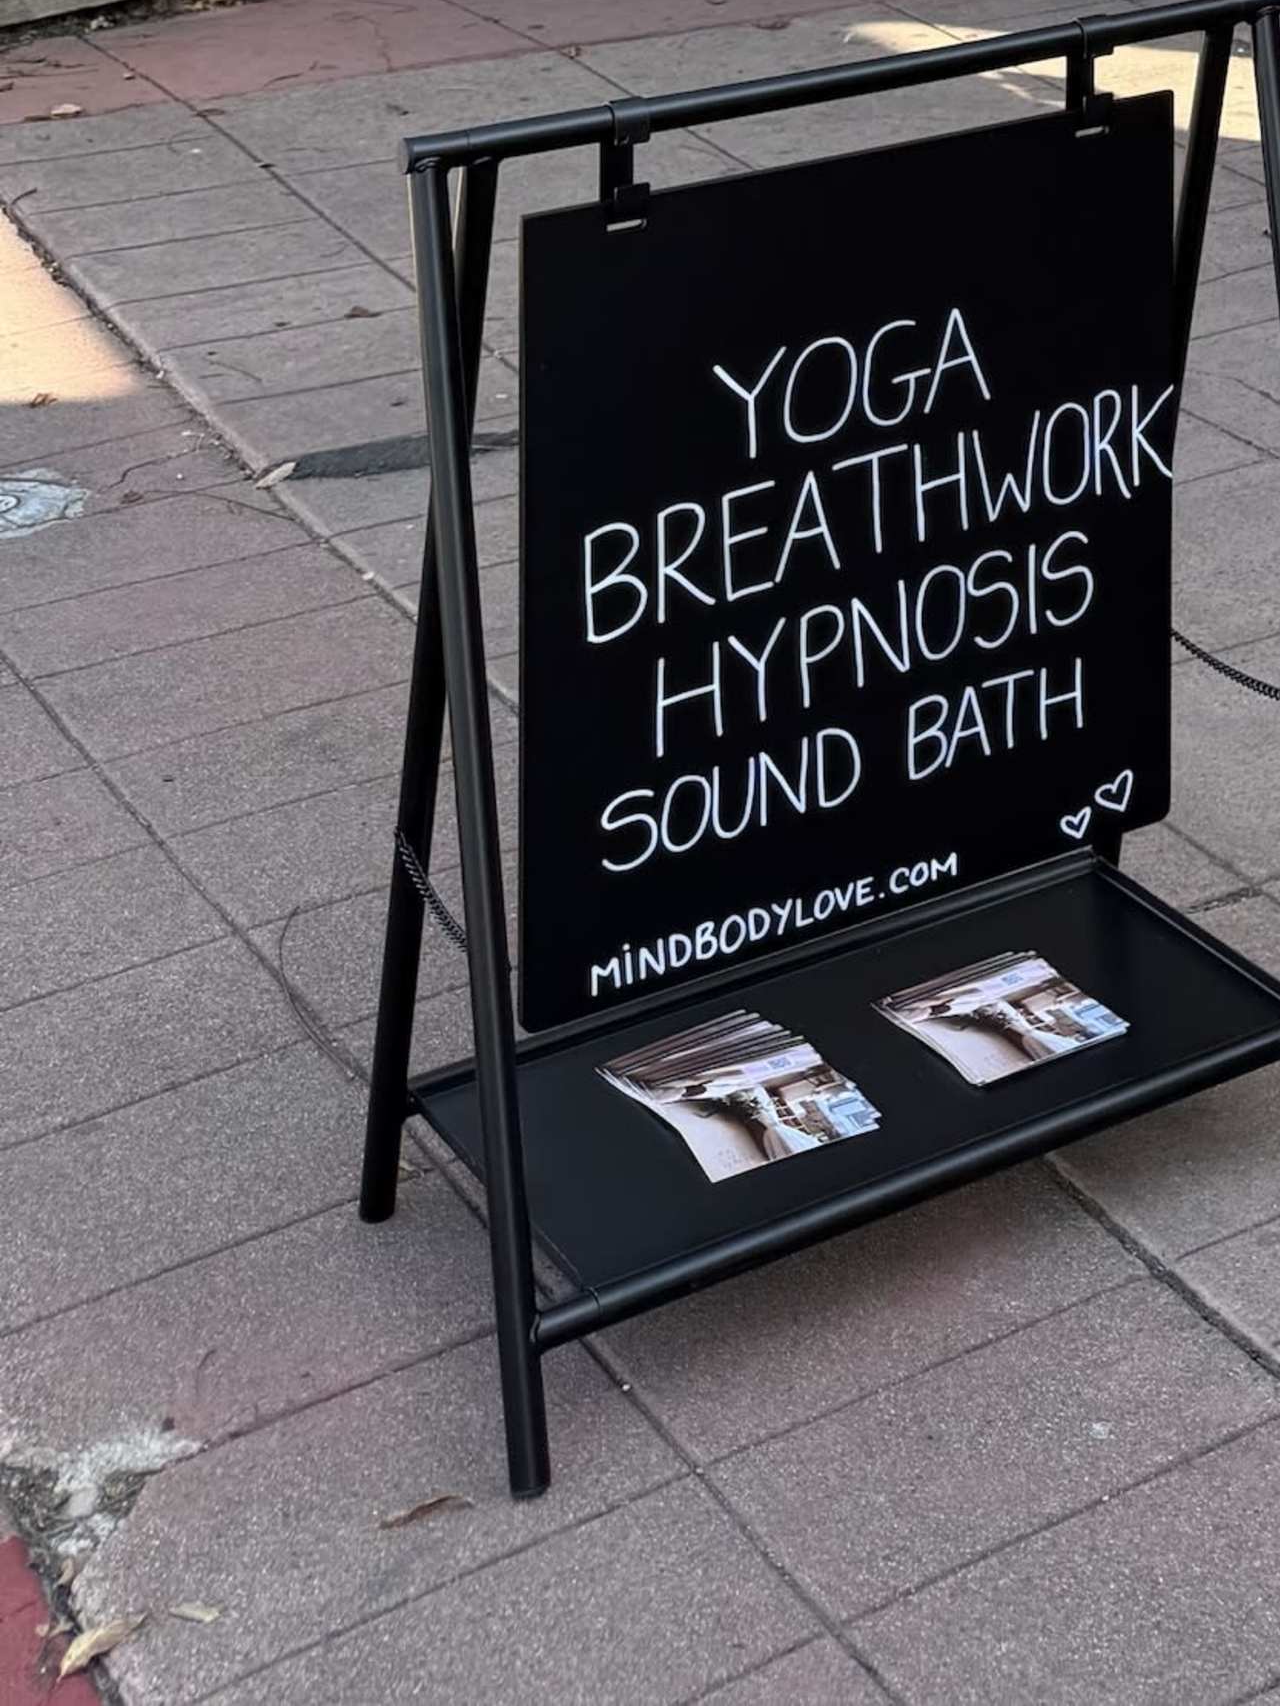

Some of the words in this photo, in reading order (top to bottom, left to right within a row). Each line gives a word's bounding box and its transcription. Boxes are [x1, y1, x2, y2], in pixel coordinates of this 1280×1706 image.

[712, 307, 990, 458] YOGA
[585, 384, 1176, 642] BREATHWORK
[654, 528, 1096, 759] HYPNOSIS
[599, 725, 866, 874] SOUND
[905, 655, 1086, 784] BATH
